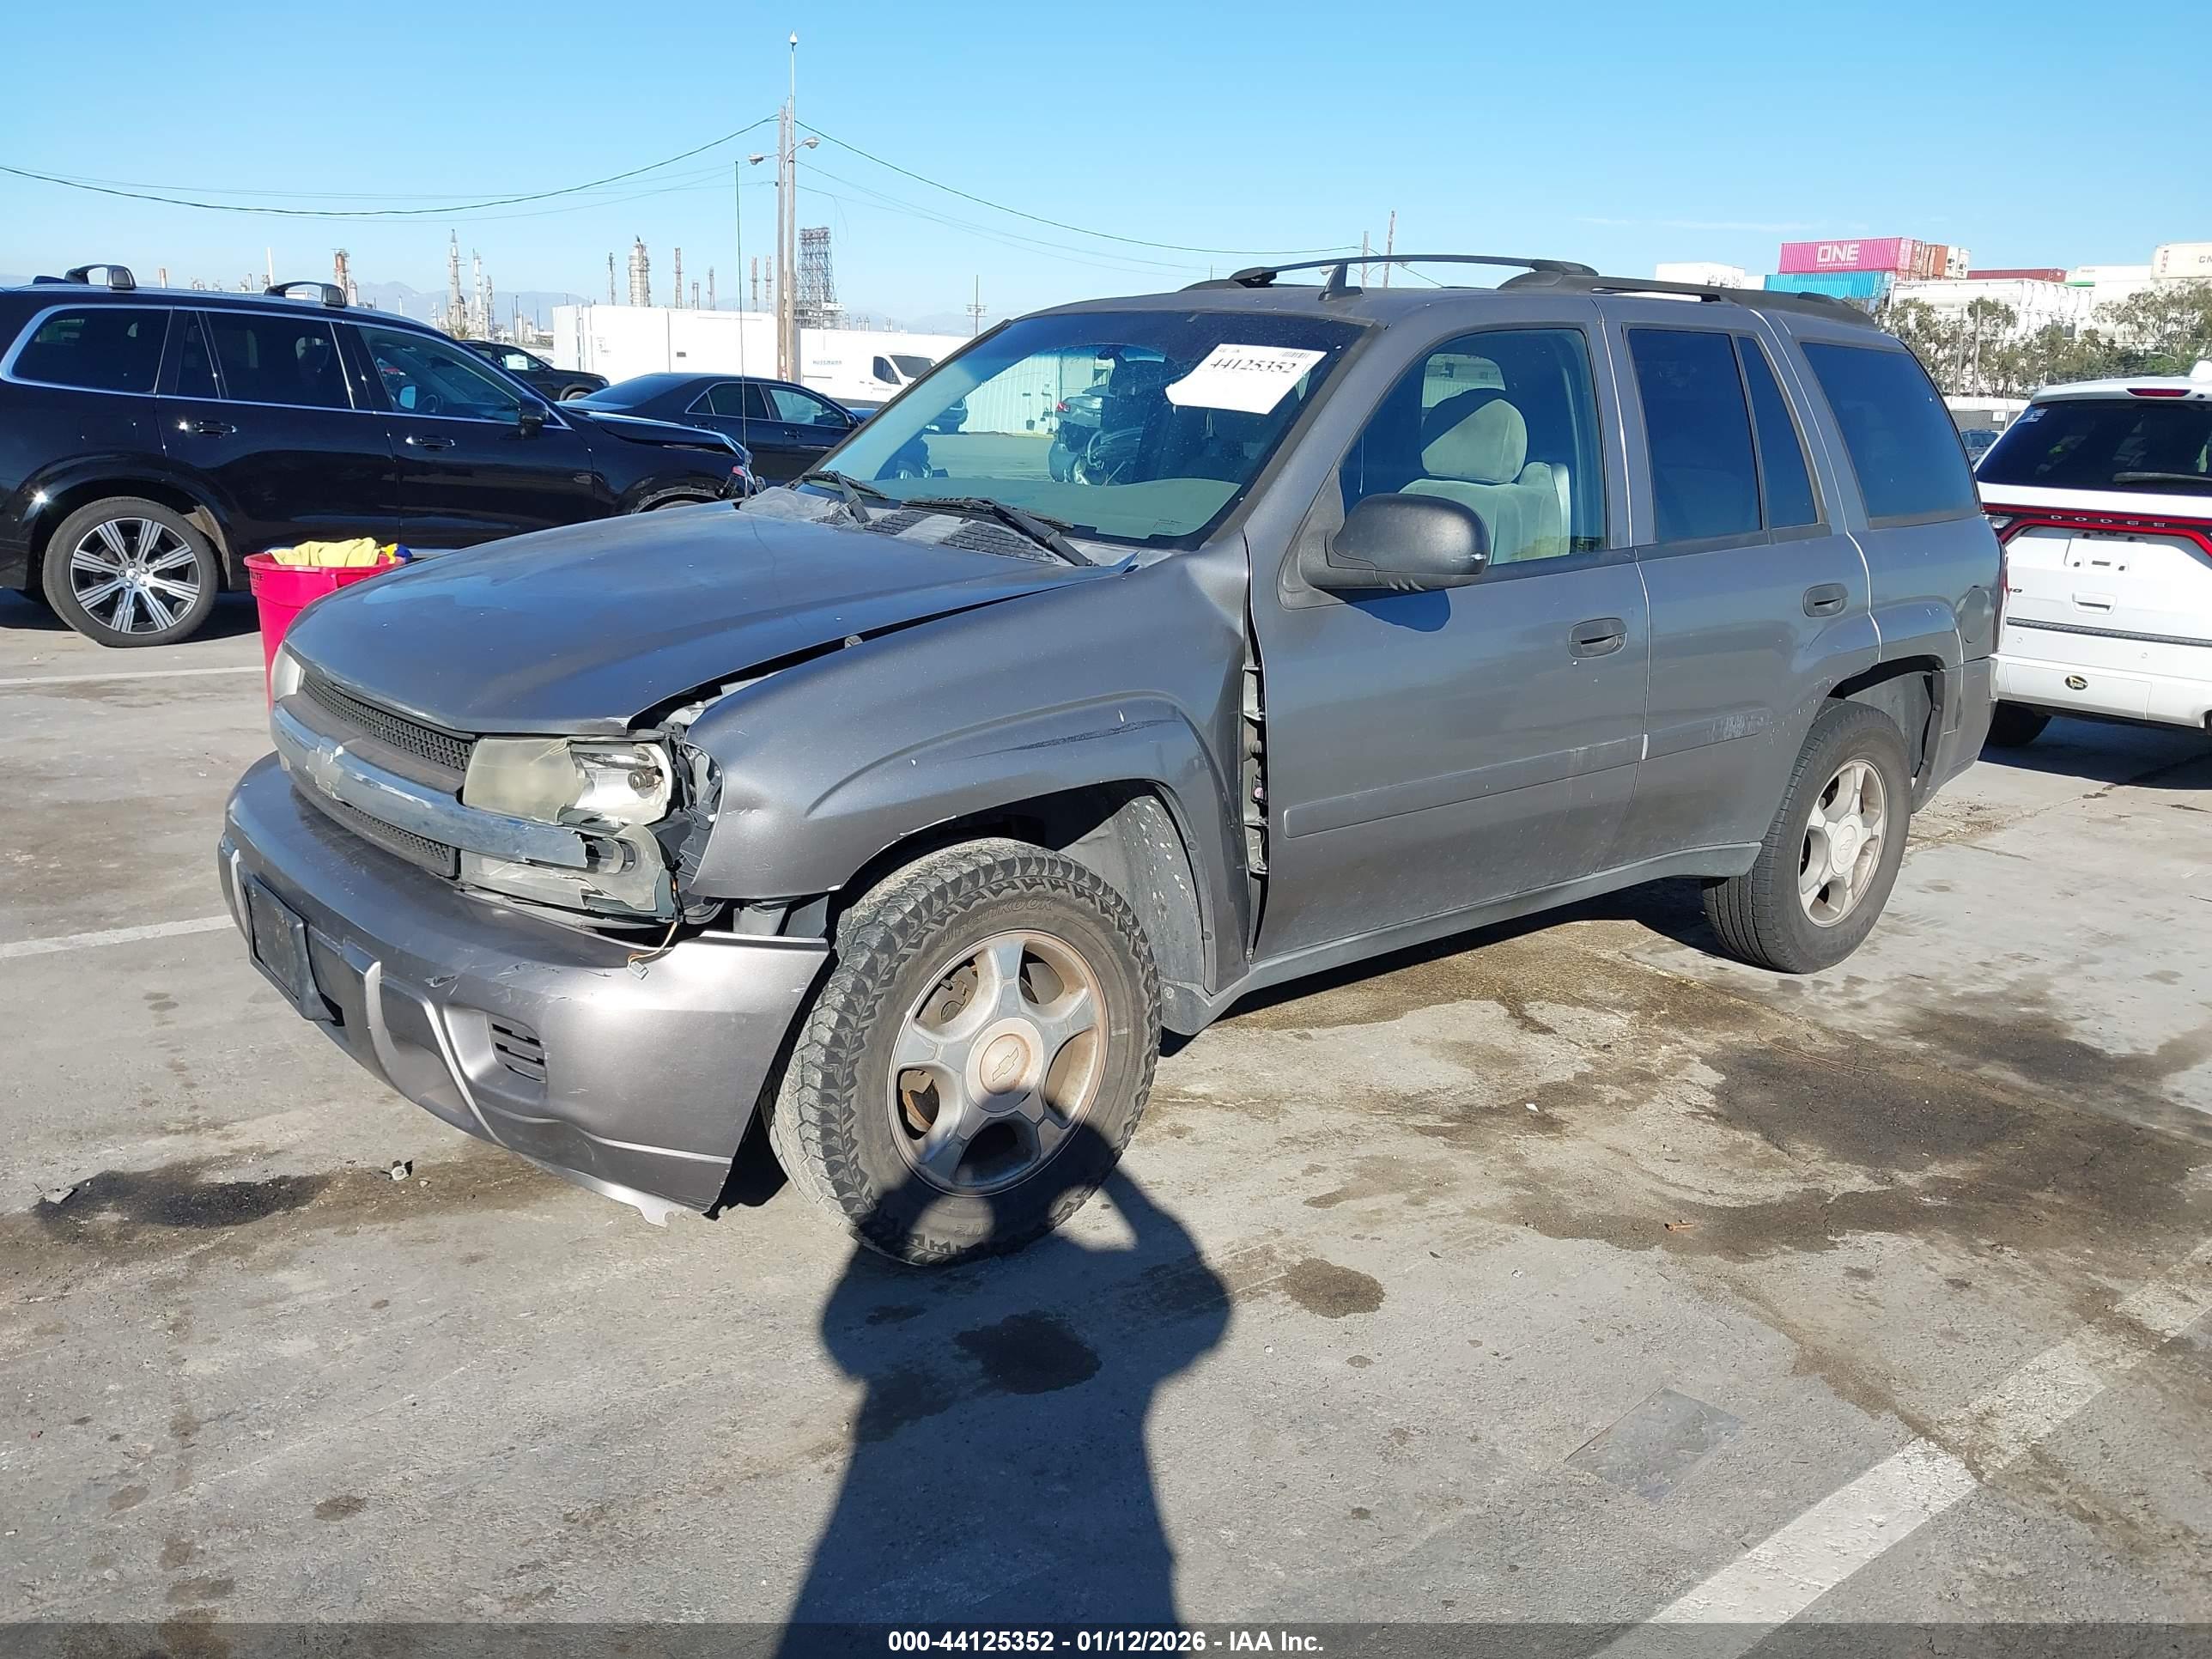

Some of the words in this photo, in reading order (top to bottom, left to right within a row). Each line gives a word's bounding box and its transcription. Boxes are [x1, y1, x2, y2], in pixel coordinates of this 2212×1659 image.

[1816, 244, 1859, 262] ONE
[1210, 358, 1297, 373] 44125352
[2050, 514, 2166, 527] DODGE
